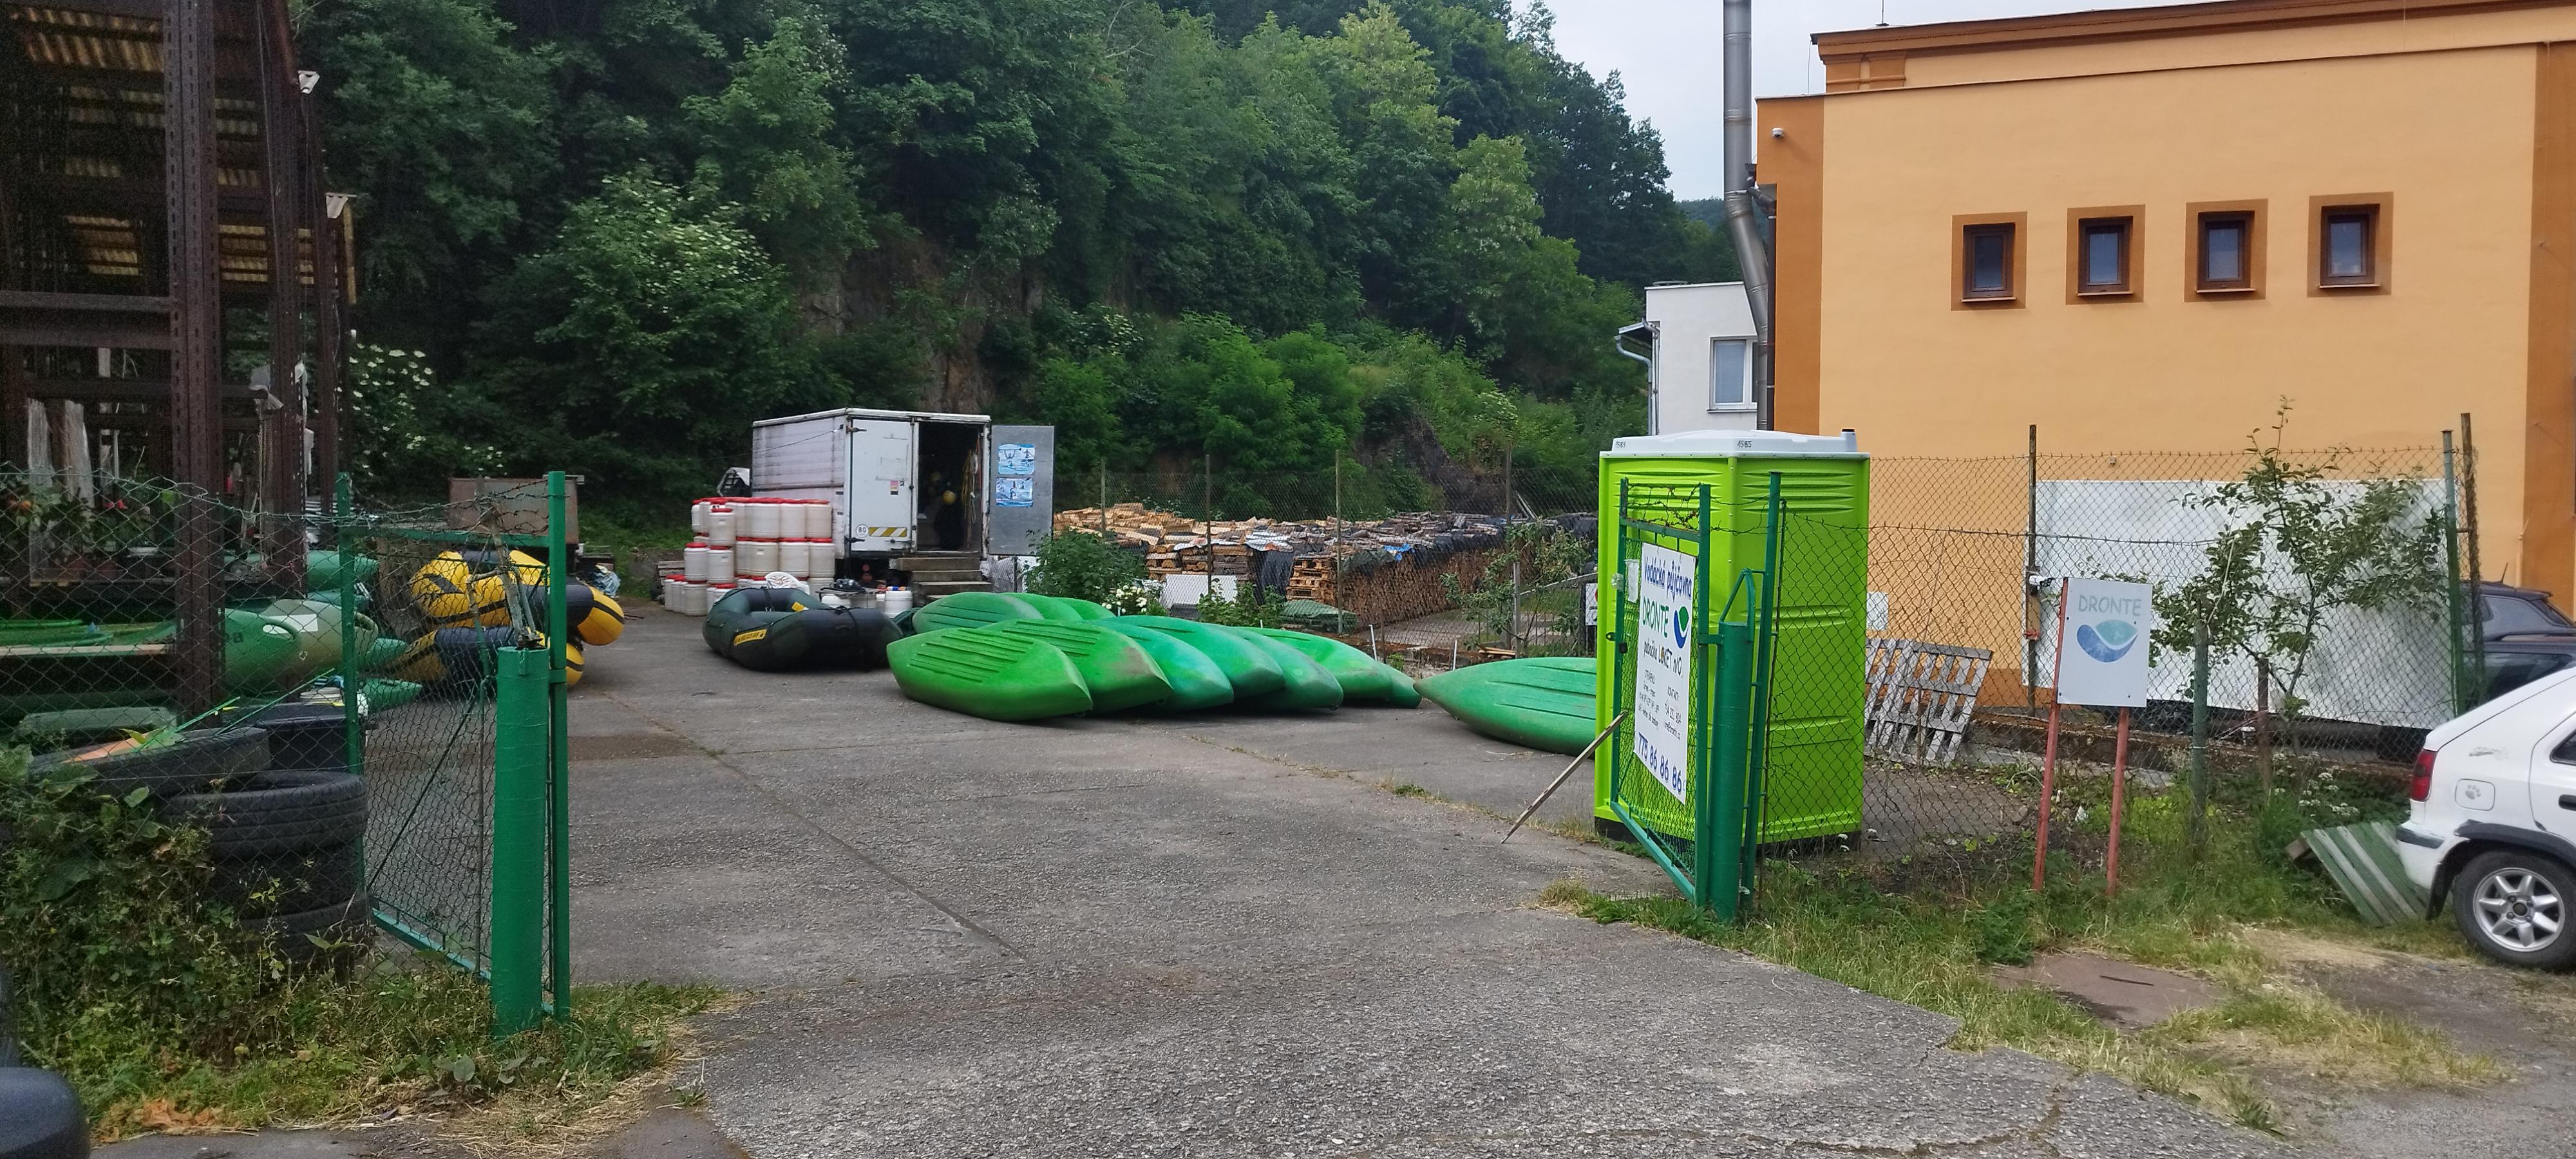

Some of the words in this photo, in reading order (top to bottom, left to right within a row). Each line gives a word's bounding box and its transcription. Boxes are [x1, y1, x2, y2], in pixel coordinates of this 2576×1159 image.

[1644, 556, 1666, 589] Vodácká
[1666, 560, 1692, 603] půjčovna
[1642, 596, 1669, 638] DRONTE
[2078, 594, 2143, 616] DRONTE
[1658, 644, 1673, 669] LOKET
[1638, 732, 1649, 761] 775
[1649, 745, 1658, 771] 86
[1660, 755, 1669, 783] 86
[1672, 764, 1682, 794] 86
